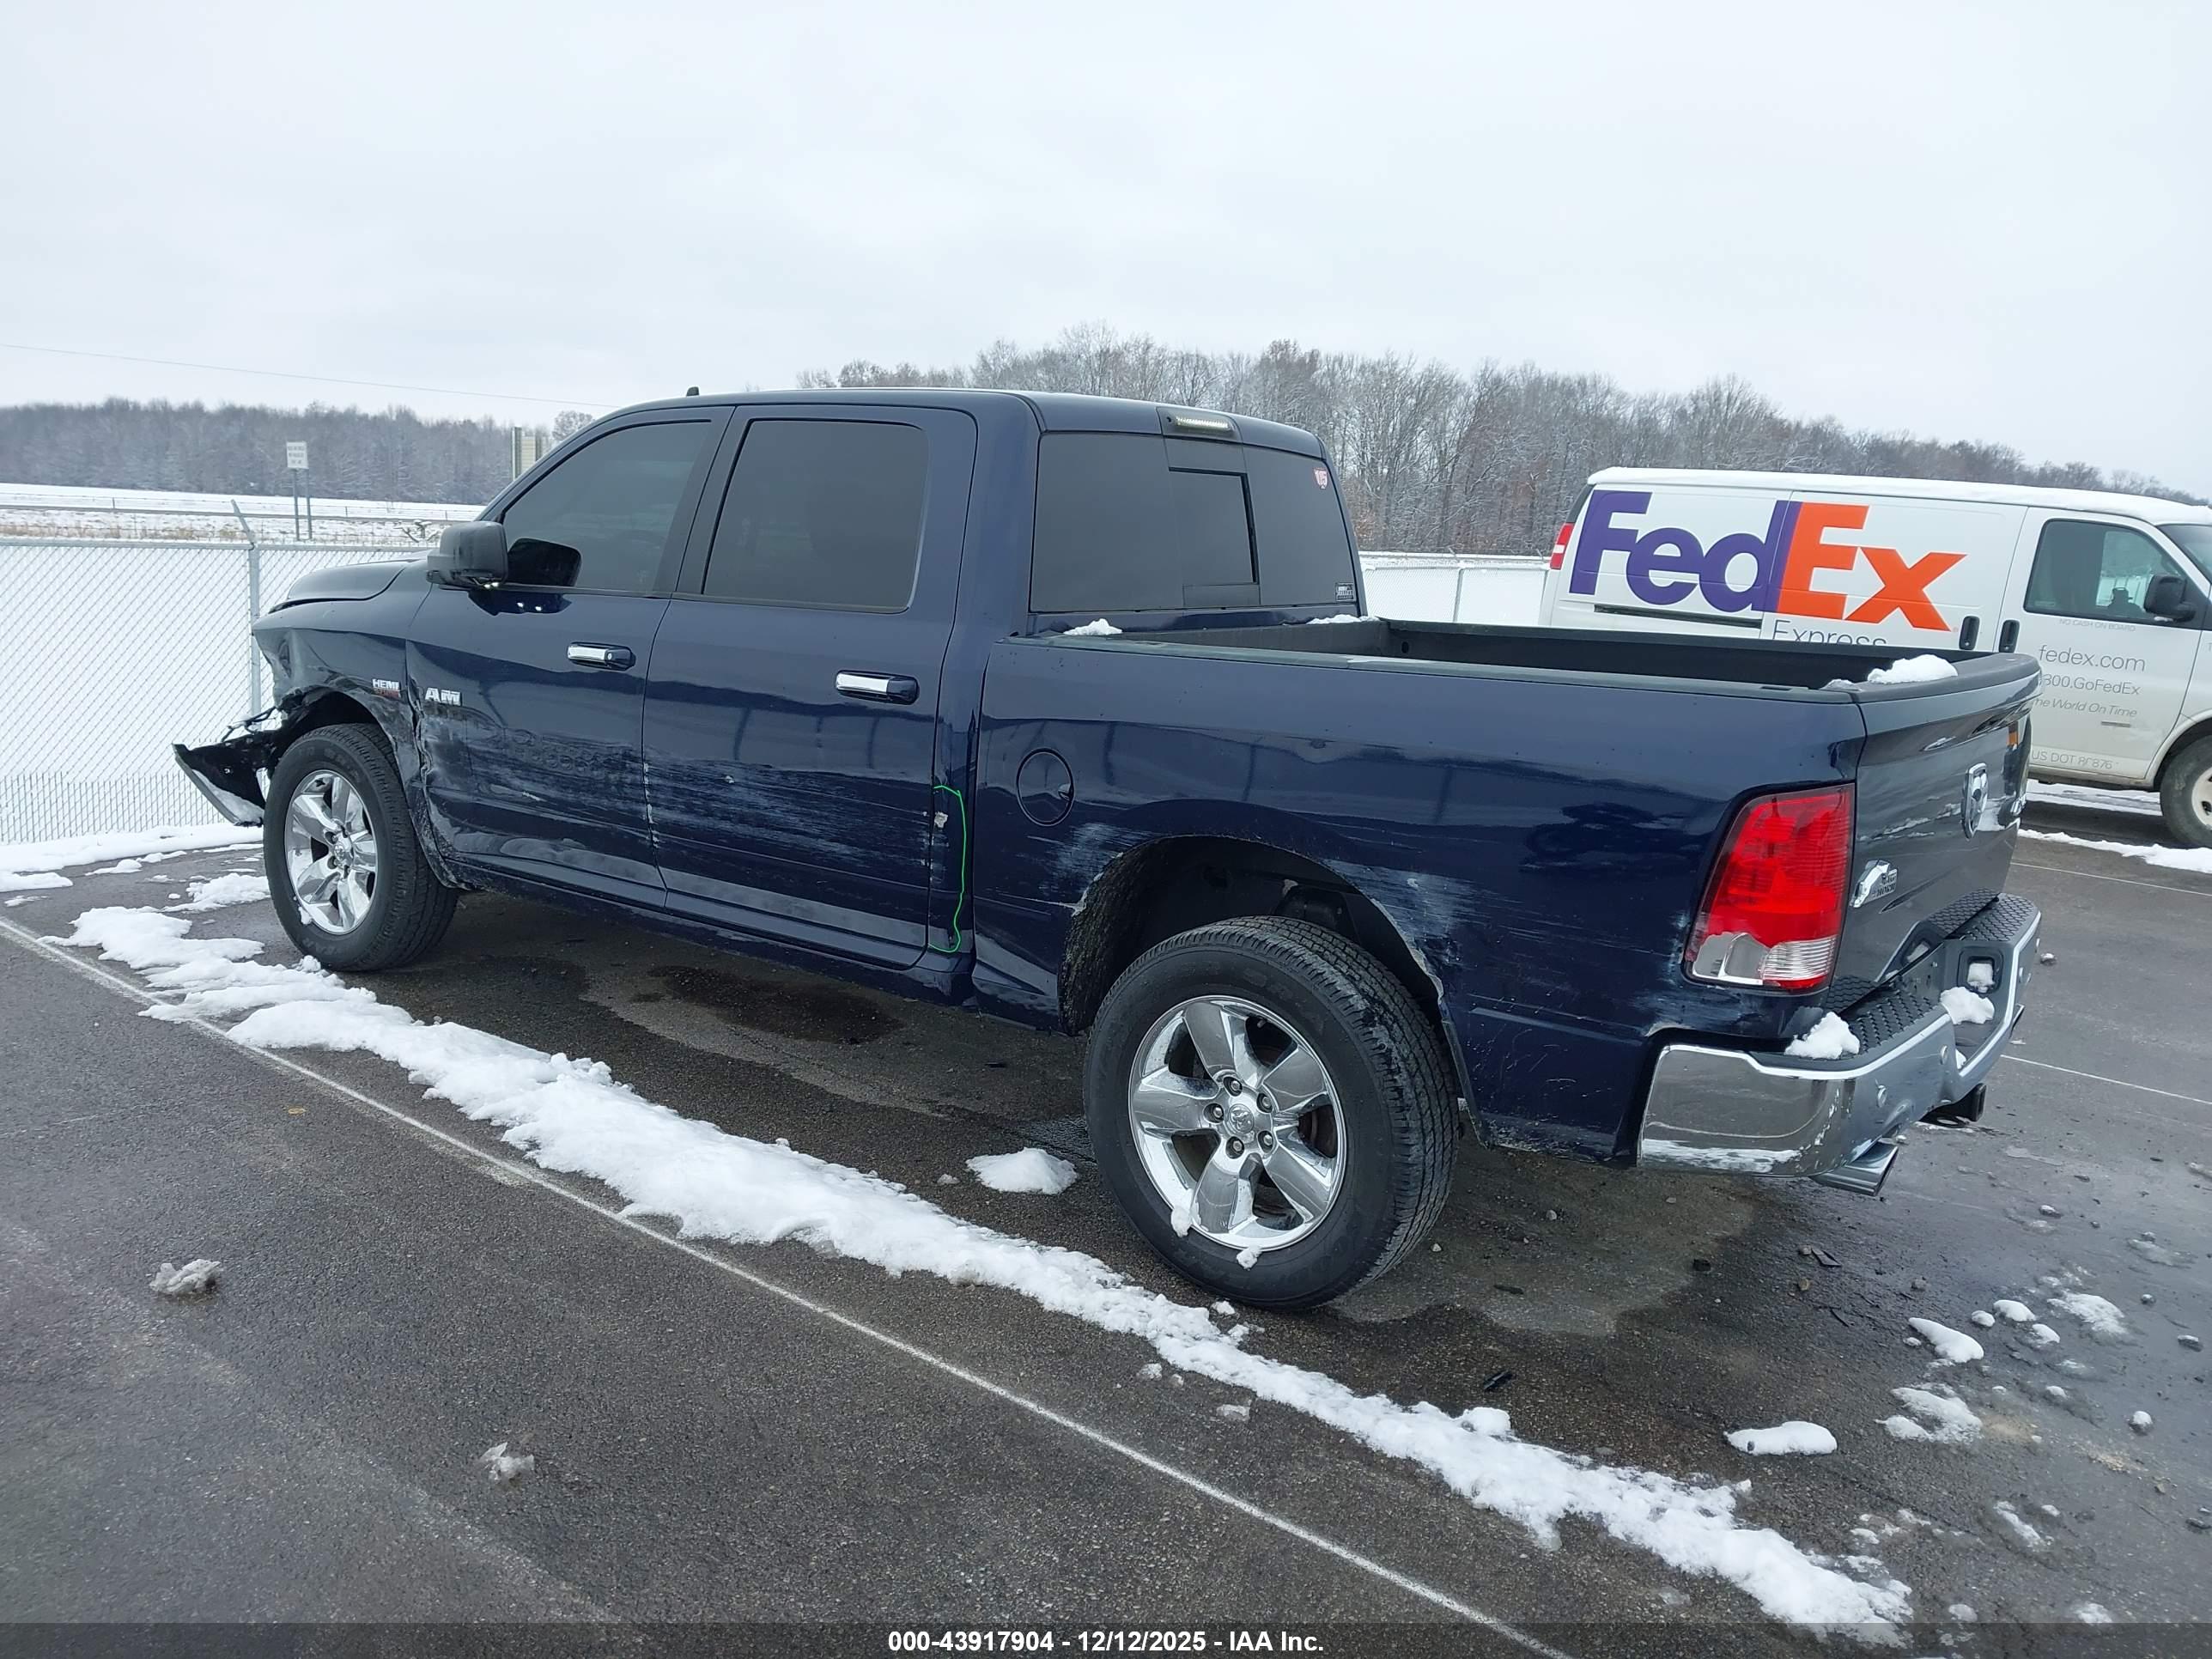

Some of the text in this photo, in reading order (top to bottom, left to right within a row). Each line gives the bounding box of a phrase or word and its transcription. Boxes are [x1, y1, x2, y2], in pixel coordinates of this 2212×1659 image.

[1569, 489, 1968, 631] FedEx
[2039, 644, 2145, 672] fedex.com
[372, 678, 400, 690] HEMI
[2035, 698, 2137, 718] he World On Time
[2031, 750, 2047, 761] US
[2051, 752, 2076, 763] DOT
